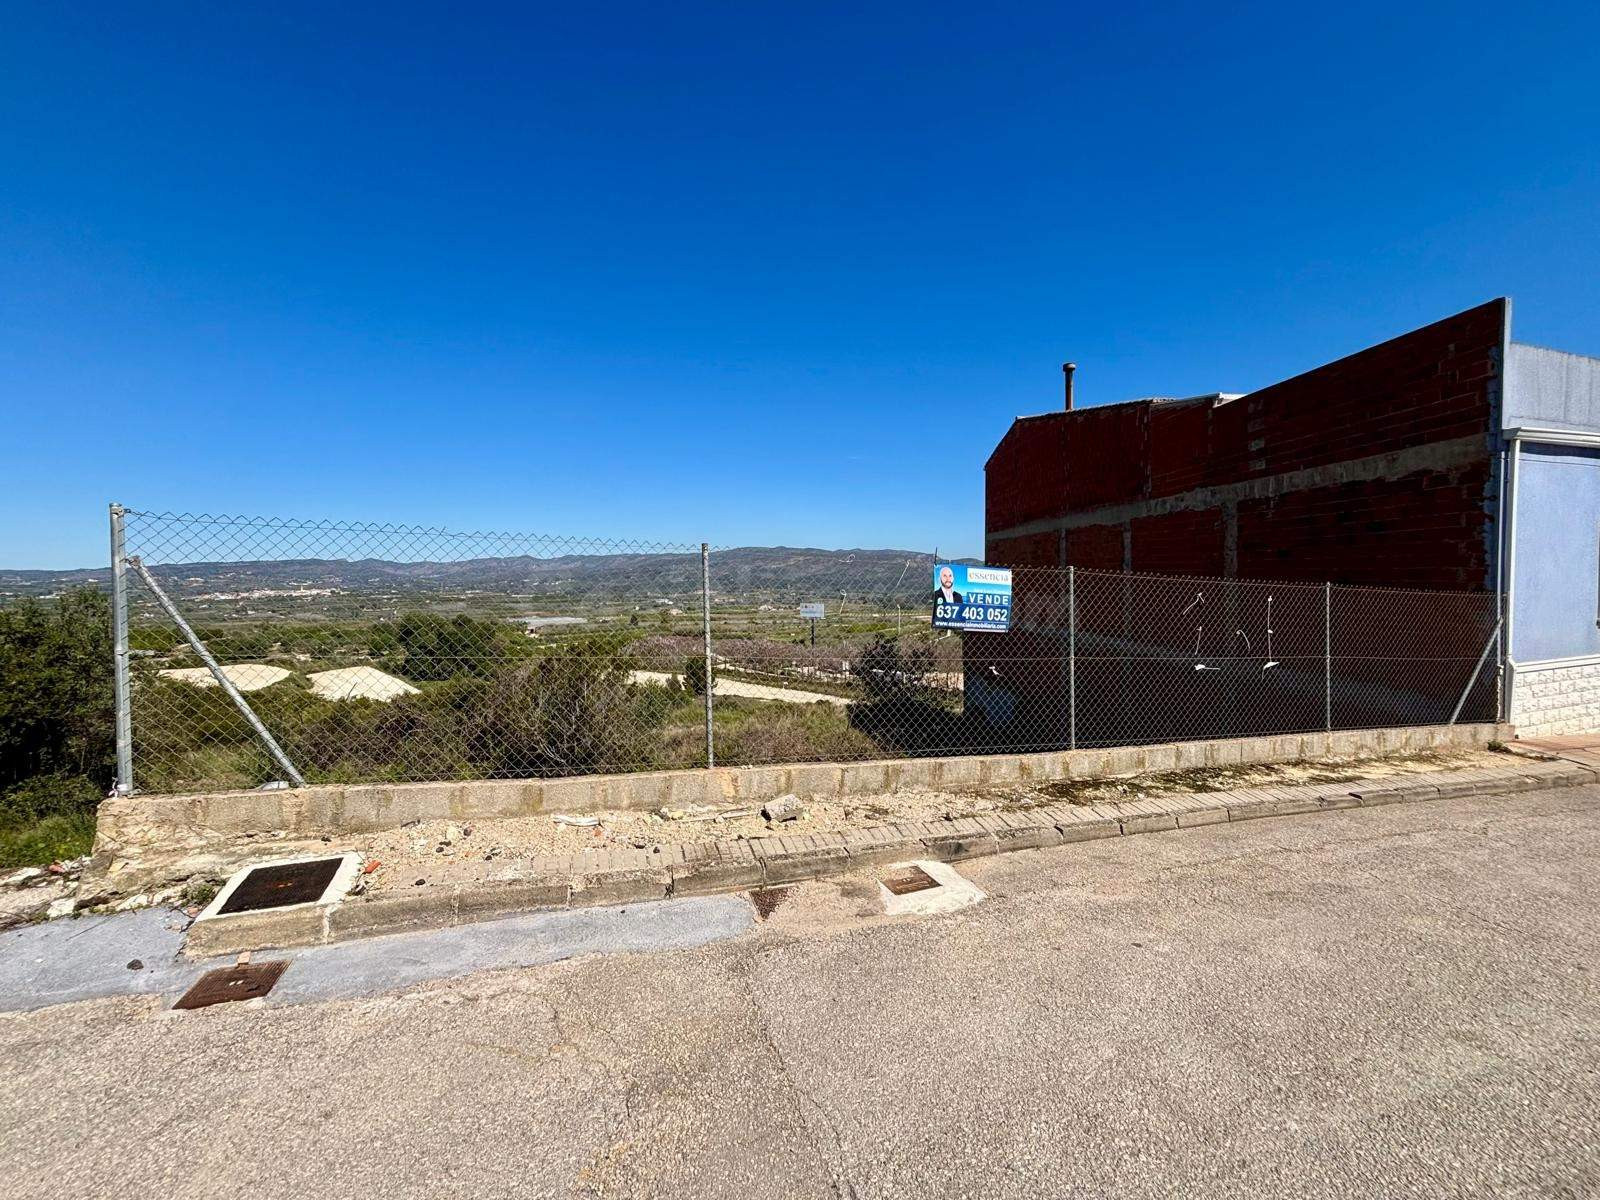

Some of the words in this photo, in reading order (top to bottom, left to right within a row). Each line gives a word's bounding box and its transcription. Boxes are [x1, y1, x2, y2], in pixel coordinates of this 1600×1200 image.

[969, 572, 1009, 582] essencia
[969, 594, 1009, 605] VENDE
[936, 605, 959, 618] 637
[962, 607, 984, 619] 403
[987, 608, 1008, 621] 052
